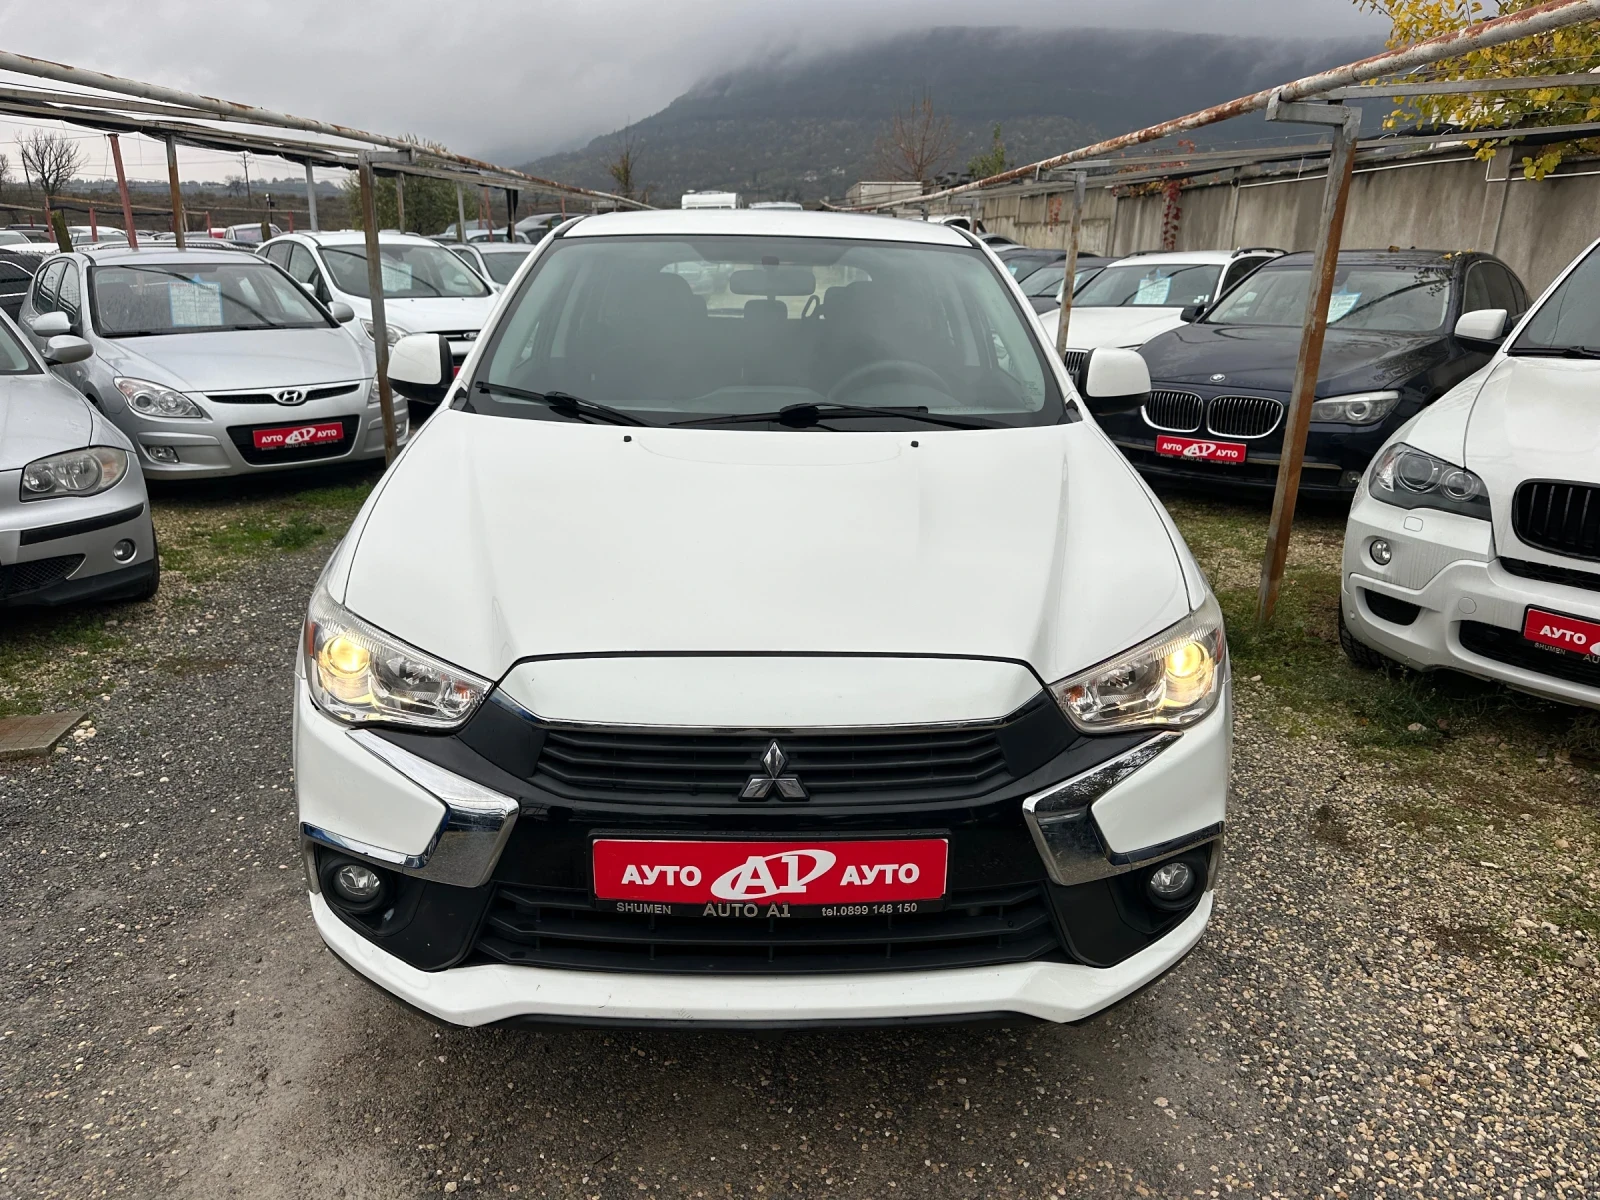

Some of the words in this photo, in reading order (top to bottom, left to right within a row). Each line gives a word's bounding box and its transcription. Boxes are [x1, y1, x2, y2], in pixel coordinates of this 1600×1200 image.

[1539, 625, 1587, 645] АУТО
[1534, 642, 1566, 655] SHUMEN
[621, 864, 702, 887] АУТО
[839, 863, 920, 886] АУТО
[616, 902, 672, 915] SHUMEN
[703, 902, 759, 918] AUTO
[766, 902, 791, 918] A1
[821, 905, 869, 917] tel.0899
[872, 904, 893, 914] 148
[897, 902, 918, 913] 150
